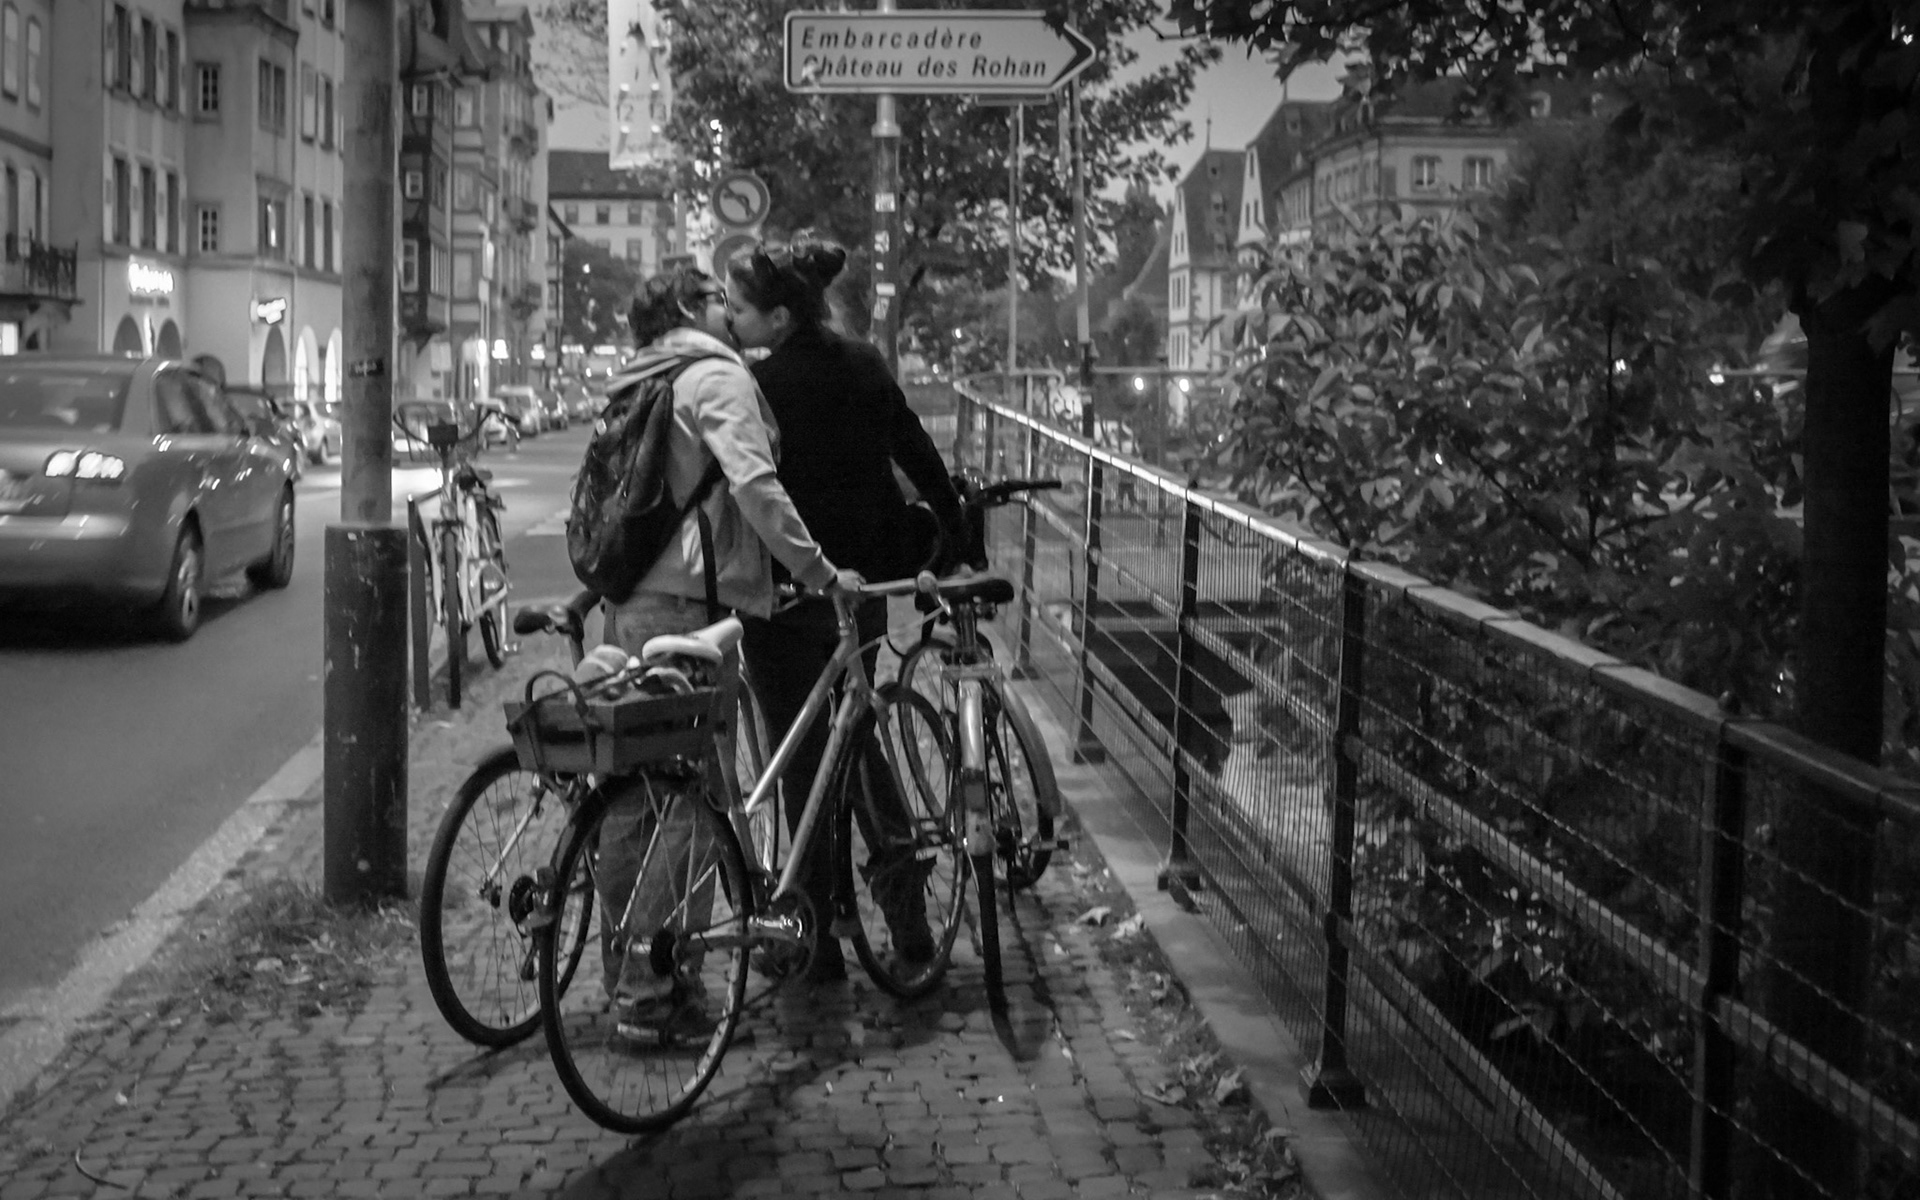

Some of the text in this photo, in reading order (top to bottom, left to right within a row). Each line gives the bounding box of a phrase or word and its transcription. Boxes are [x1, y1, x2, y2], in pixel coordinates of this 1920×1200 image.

[802, 26, 982, 49] Embarcadère
[918, 55, 957, 78] des
[972, 54, 1046, 78] Rohan
